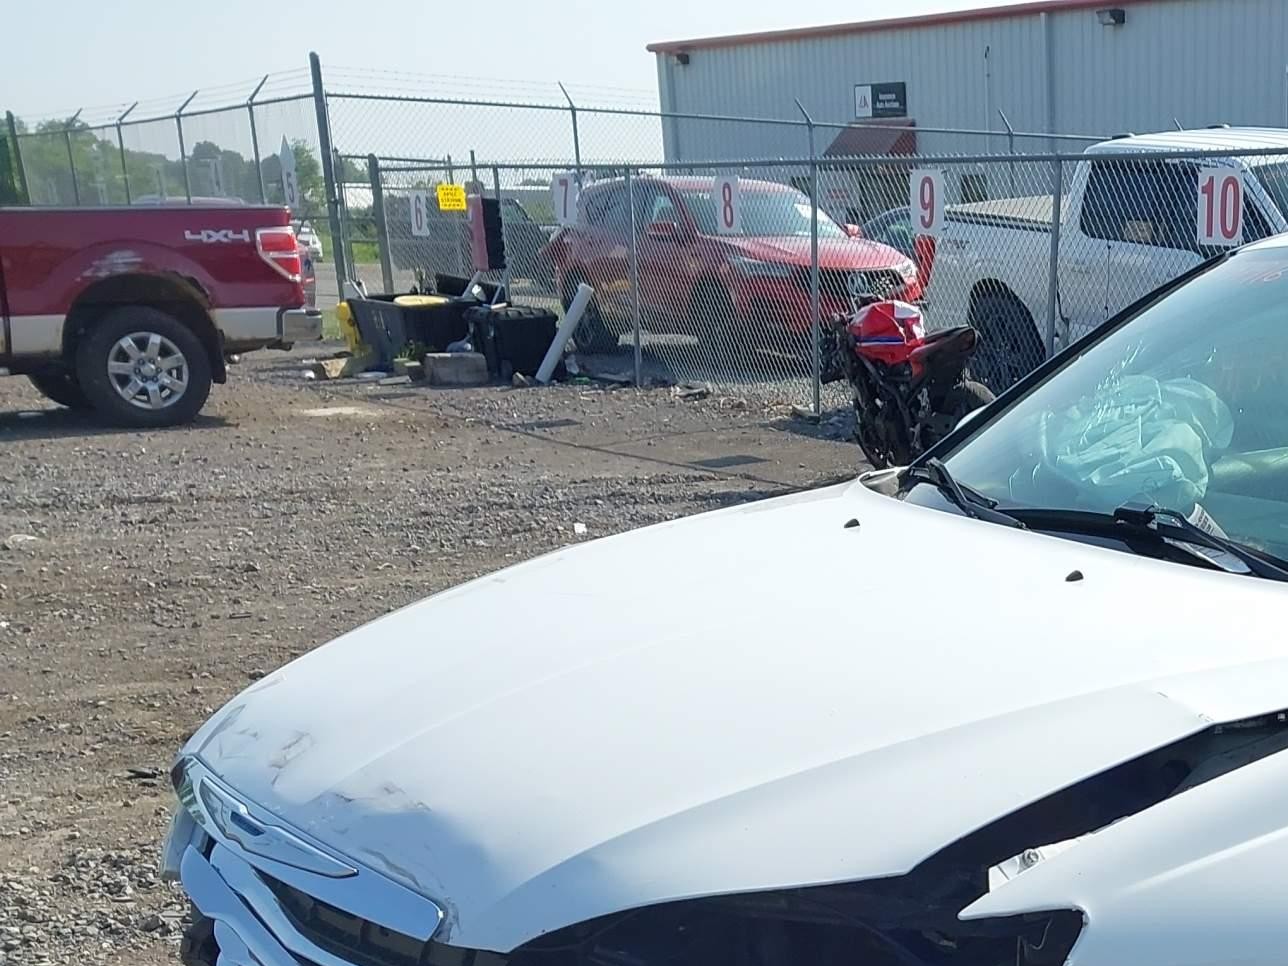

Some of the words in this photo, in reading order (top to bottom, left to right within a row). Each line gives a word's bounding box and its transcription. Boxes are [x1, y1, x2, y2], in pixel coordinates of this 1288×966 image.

[414, 194, 423, 231] 6
[558, 178, 569, 219] 7
[722, 181, 734, 229] 8
[919, 175, 935, 229] 9
[1201, 175, 1240, 239] 10
